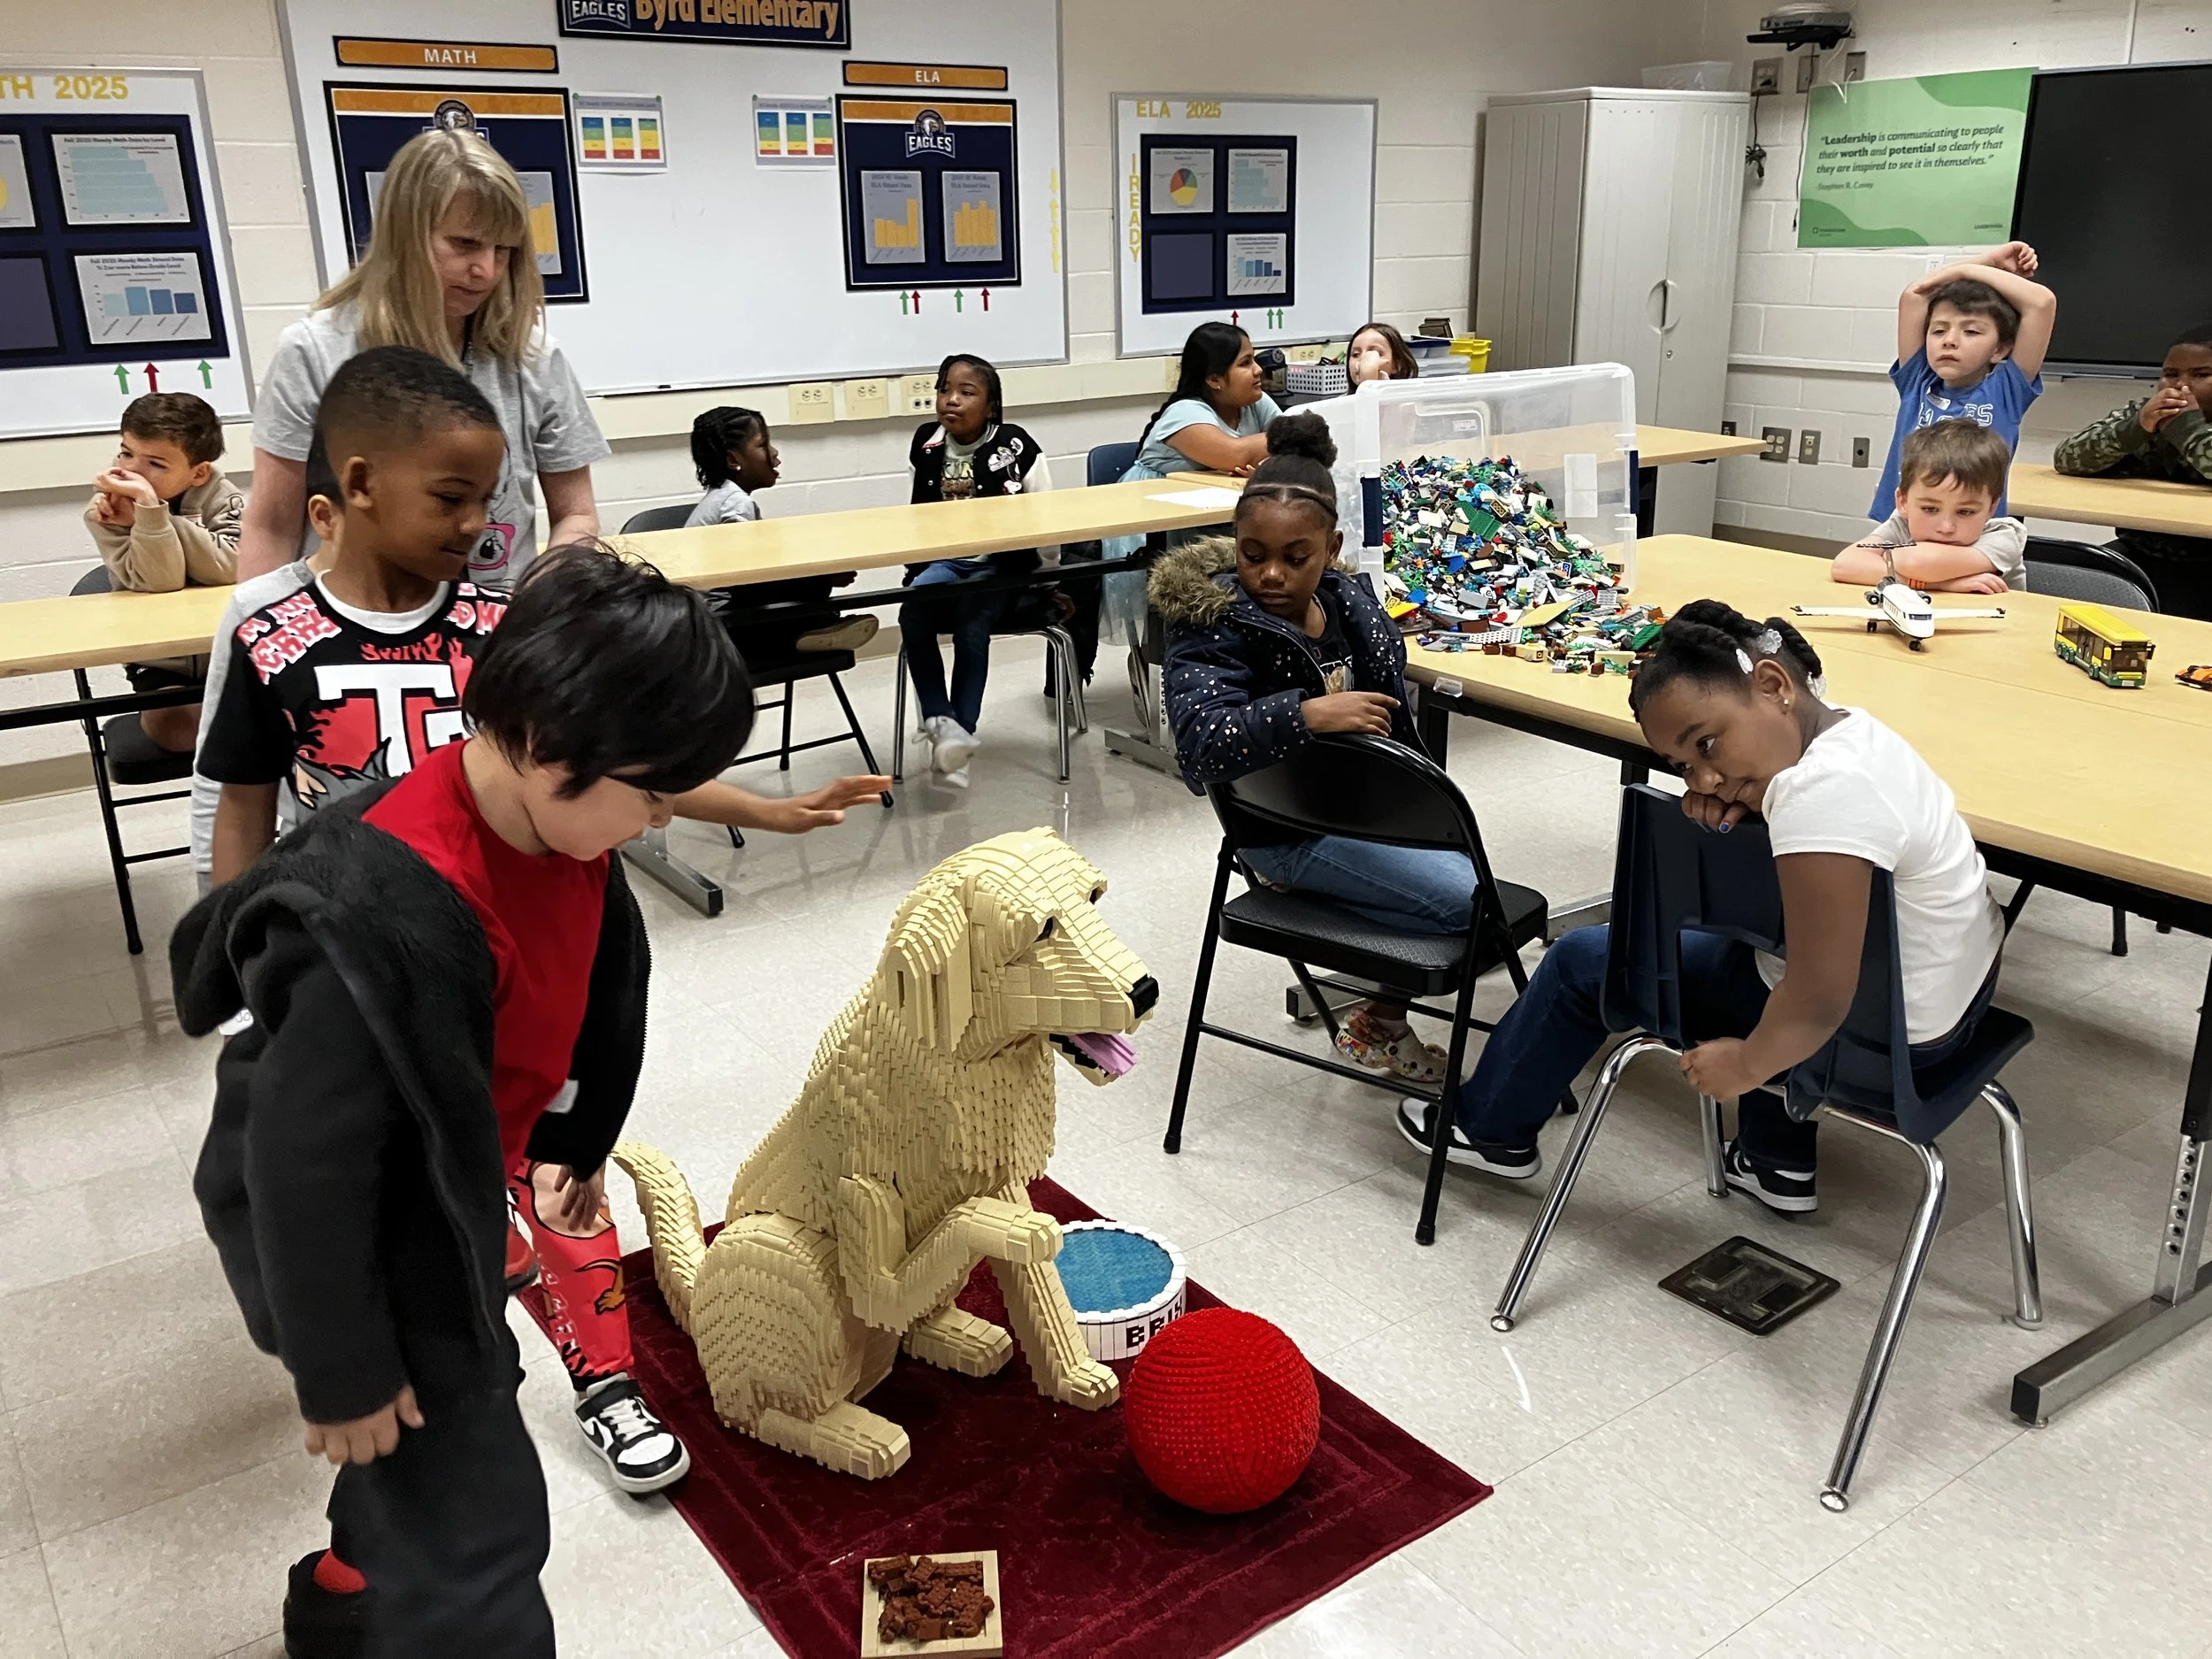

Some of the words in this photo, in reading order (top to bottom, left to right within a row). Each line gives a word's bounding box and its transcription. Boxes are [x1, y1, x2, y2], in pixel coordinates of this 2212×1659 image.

[572, 1, 626, 21] EAGLES
[635, 0, 696, 31] Byrd
[701, 0, 839, 39] Elementary
[425, 48, 477, 65] MATH
[915, 70, 941, 83] ELA
[54, 74, 129, 100] 2025
[1136, 100, 1171, 118] ELA
[1186, 102, 1222, 119] 2025
[1878, 132, 1886, 142] is
[1887, 127, 1959, 141] communicating
[1961, 127, 1971, 136] to
[1972, 125, 2004, 138] people
[908, 135, 953, 152] EAGLES
[1819, 150, 1839, 159] their
[1840, 147, 1868, 157] worth
[1870, 146, 1887, 157] and
[1889, 142, 1936, 157] potential
[1949, 141, 1981, 152] clearly
[1982, 140, 2003, 150] that
[1816, 164, 1835, 175] they
[1852, 161, 1886, 173] inspired
[1888, 161, 1897, 170] to
[1914, 159, 1922, 168] it
[1923, 158, 1932, 167] in
